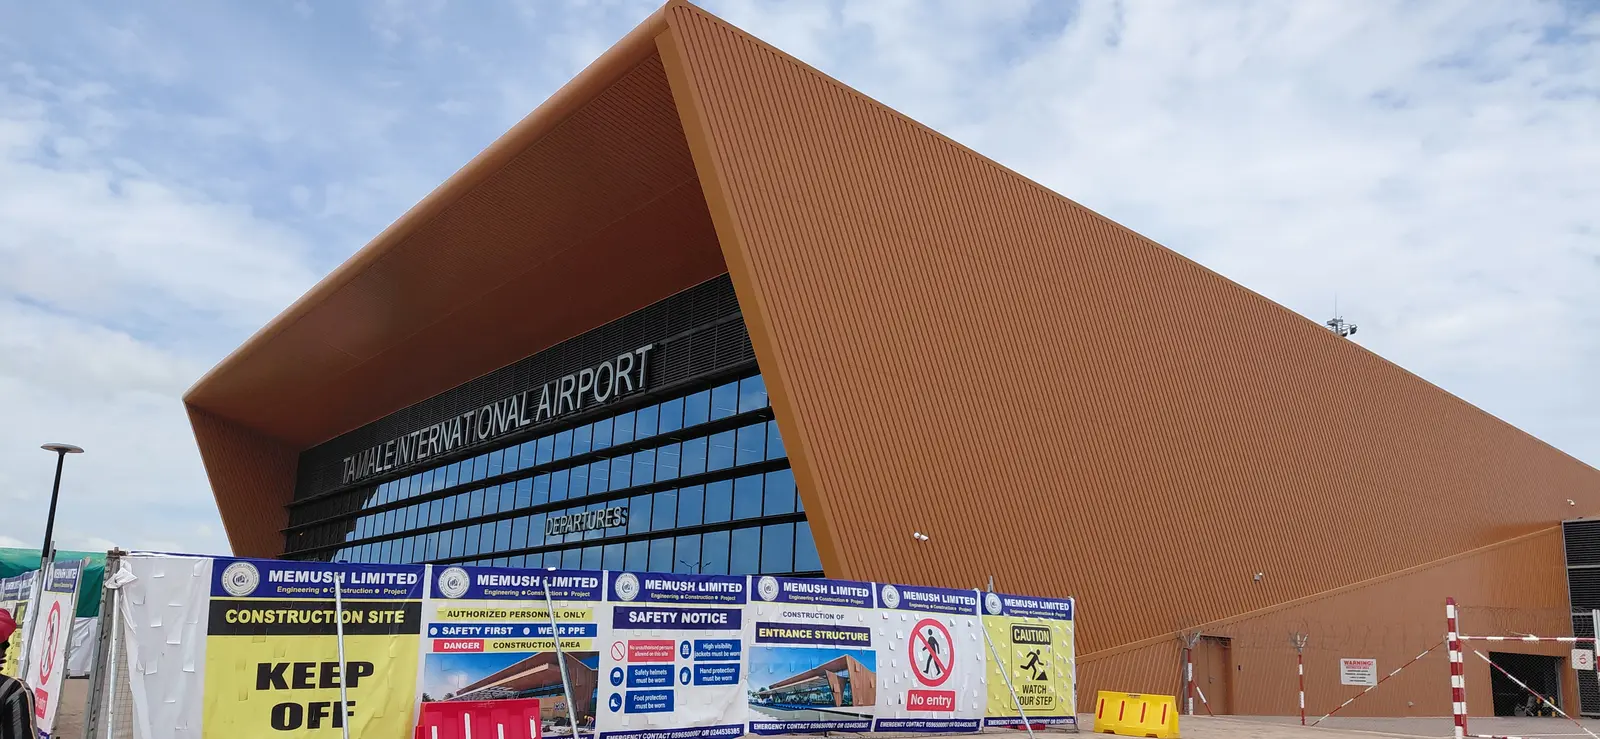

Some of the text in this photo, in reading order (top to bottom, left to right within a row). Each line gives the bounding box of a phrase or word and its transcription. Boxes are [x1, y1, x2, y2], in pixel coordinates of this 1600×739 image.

[342, 343, 653, 484] TAMALE INTERNATIONAL AIRPORT
[545, 506, 621, 535] DEPARTURES
[268, 570, 418, 585] MEMUSH LIMITED
[477, 574, 540, 586] MEMUSH
[277, 586, 320, 594] Engineering
[384, 588, 406, 596] Project
[645, 579, 696, 592] MEMUSH
[698, 582, 742, 593] LIMITED
[784, 582, 828, 594] MEMUSH
[830, 585, 869, 597] LIMITED
[484, 589, 519, 597] Engineering
[651, 592, 680, 600] Engineering
[788, 594, 814, 602] Engineering
[903, 591, 940, 602] MEMUSH
[942, 594, 976, 606] LIMITED
[1004, 598, 1038, 608] MEMUSH
[1040, 601, 1070, 610] LIMITED
[226, 610, 405, 624] CONSTRUCTION SITE
[447, 610, 506, 618] AUTHORIZED
[628, 611, 728, 624] SAFETY NOTICE
[782, 611, 834, 620] CONSTRUCTION
[442, 626, 514, 635] SAFETY FIRST
[538, 627, 586, 635] WER PPE
[759, 628, 869, 642] ENTRANCE STRUCTURE
[1014, 628, 1050, 643] CAUTION
[444, 642, 480, 650] DANGER
[492, 642, 556, 650] CONSTRUCTION
[256, 662, 374, 690] KEEP
[1022, 684, 1046, 694] WATCH
[910, 694, 952, 708] No entry
[1016, 696, 1052, 705] OUR STEP
[270, 701, 356, 731] OFF
